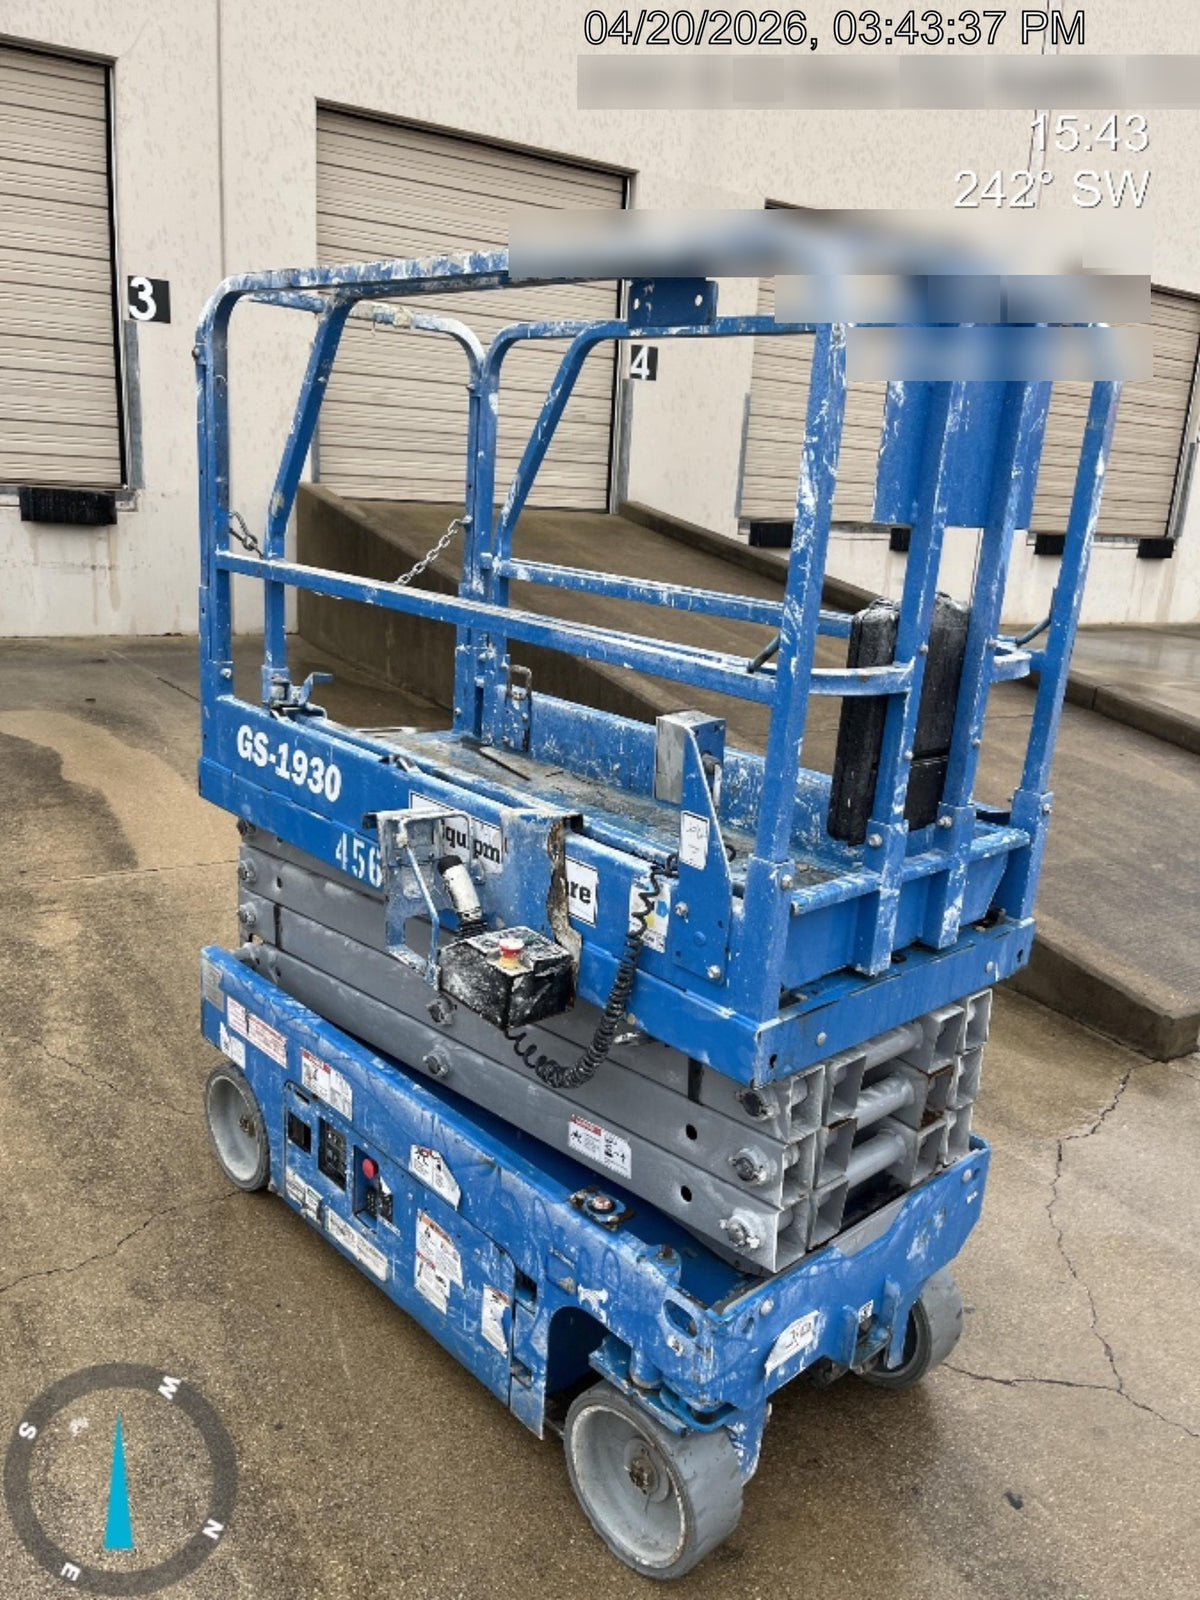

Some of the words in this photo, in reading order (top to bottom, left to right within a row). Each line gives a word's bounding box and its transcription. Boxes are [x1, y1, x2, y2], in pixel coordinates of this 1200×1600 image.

[129, 277, 157, 320] 3
[631, 345, 650, 380] 4
[237, 725, 342, 802] GS-1930
[335, 832, 383, 888] 456
